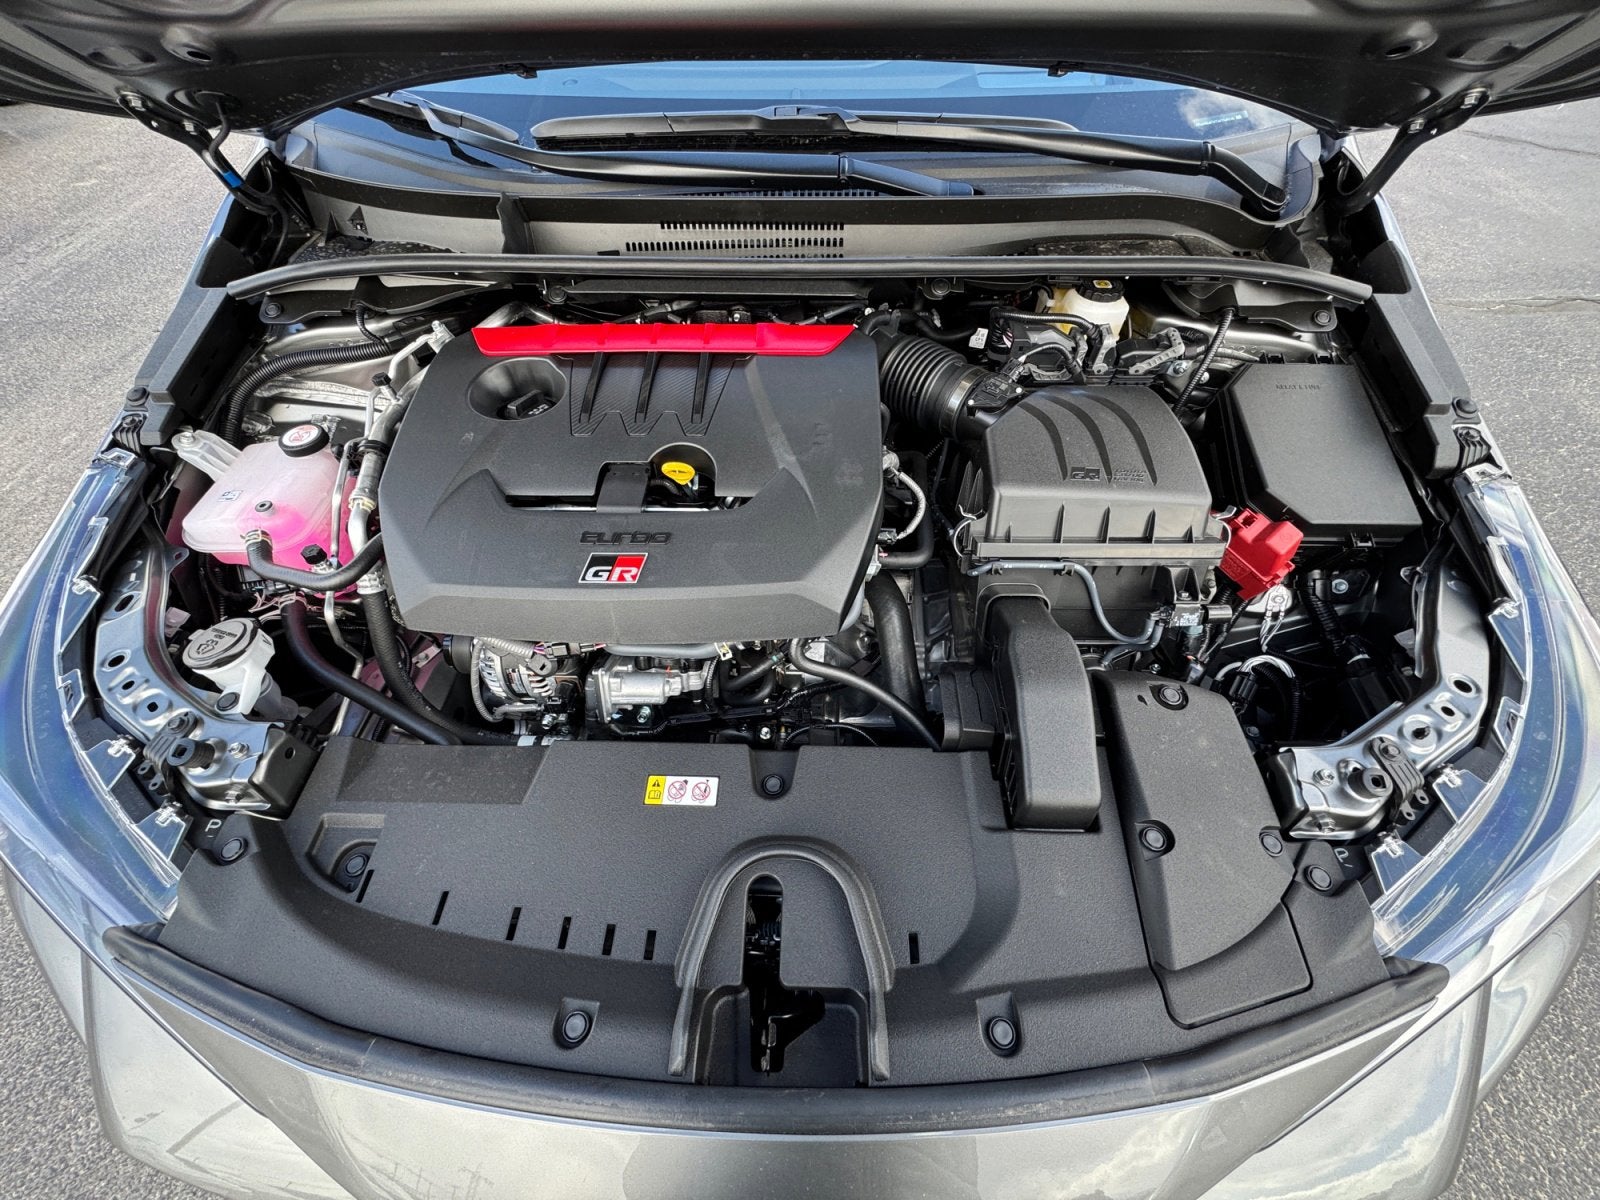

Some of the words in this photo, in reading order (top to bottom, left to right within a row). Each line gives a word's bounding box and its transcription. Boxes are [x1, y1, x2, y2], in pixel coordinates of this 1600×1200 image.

[579, 530, 673, 545] turbo
[584, 565, 639, 582] GR
[204, 818, 222, 832] P
[1334, 847, 1349, 863] P
